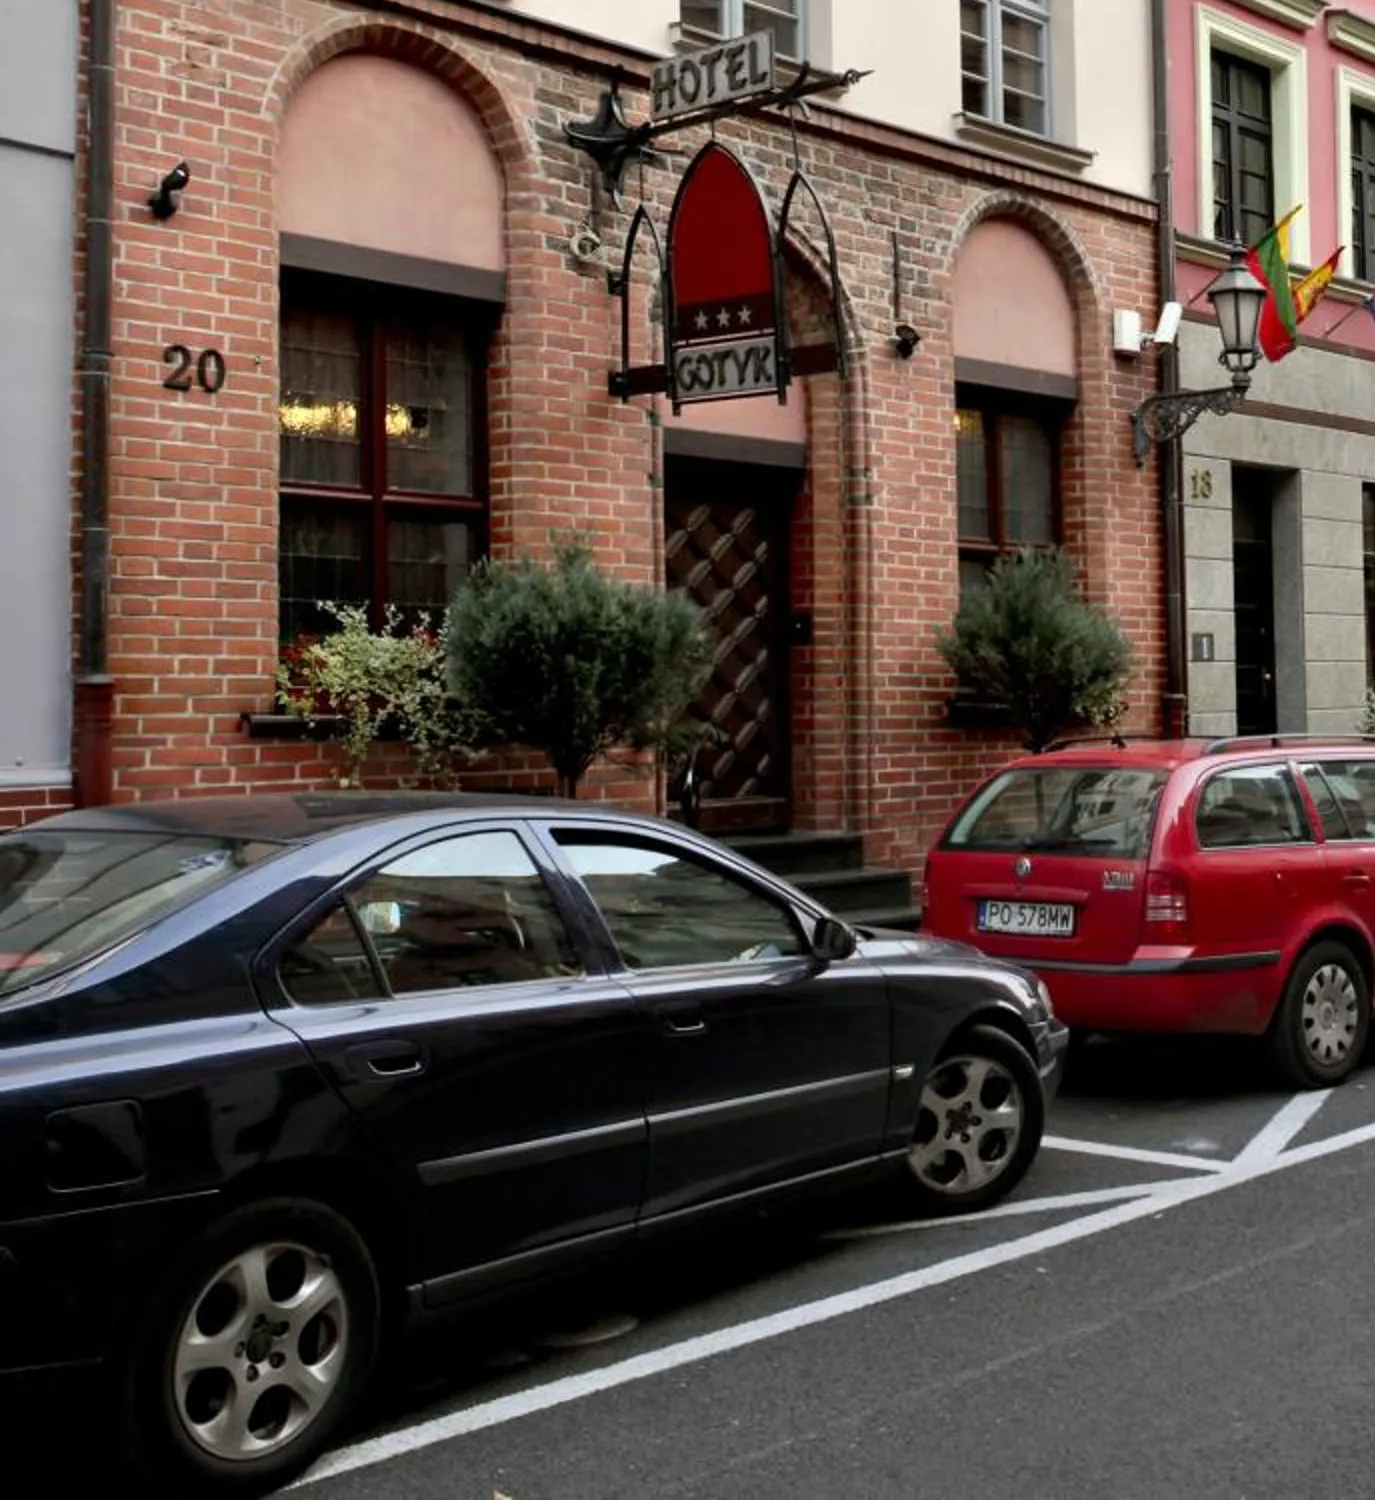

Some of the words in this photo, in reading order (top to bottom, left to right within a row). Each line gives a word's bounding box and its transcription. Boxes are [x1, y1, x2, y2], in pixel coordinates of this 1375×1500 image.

[653, 41, 769, 112] HOTEL
[162, 345, 226, 394] 20
[678, 346, 772, 392] GOTYK
[1191, 468, 1213, 500] 18
[989, 904, 1012, 925] PO
[1018, 905, 1071, 929] 578MW
